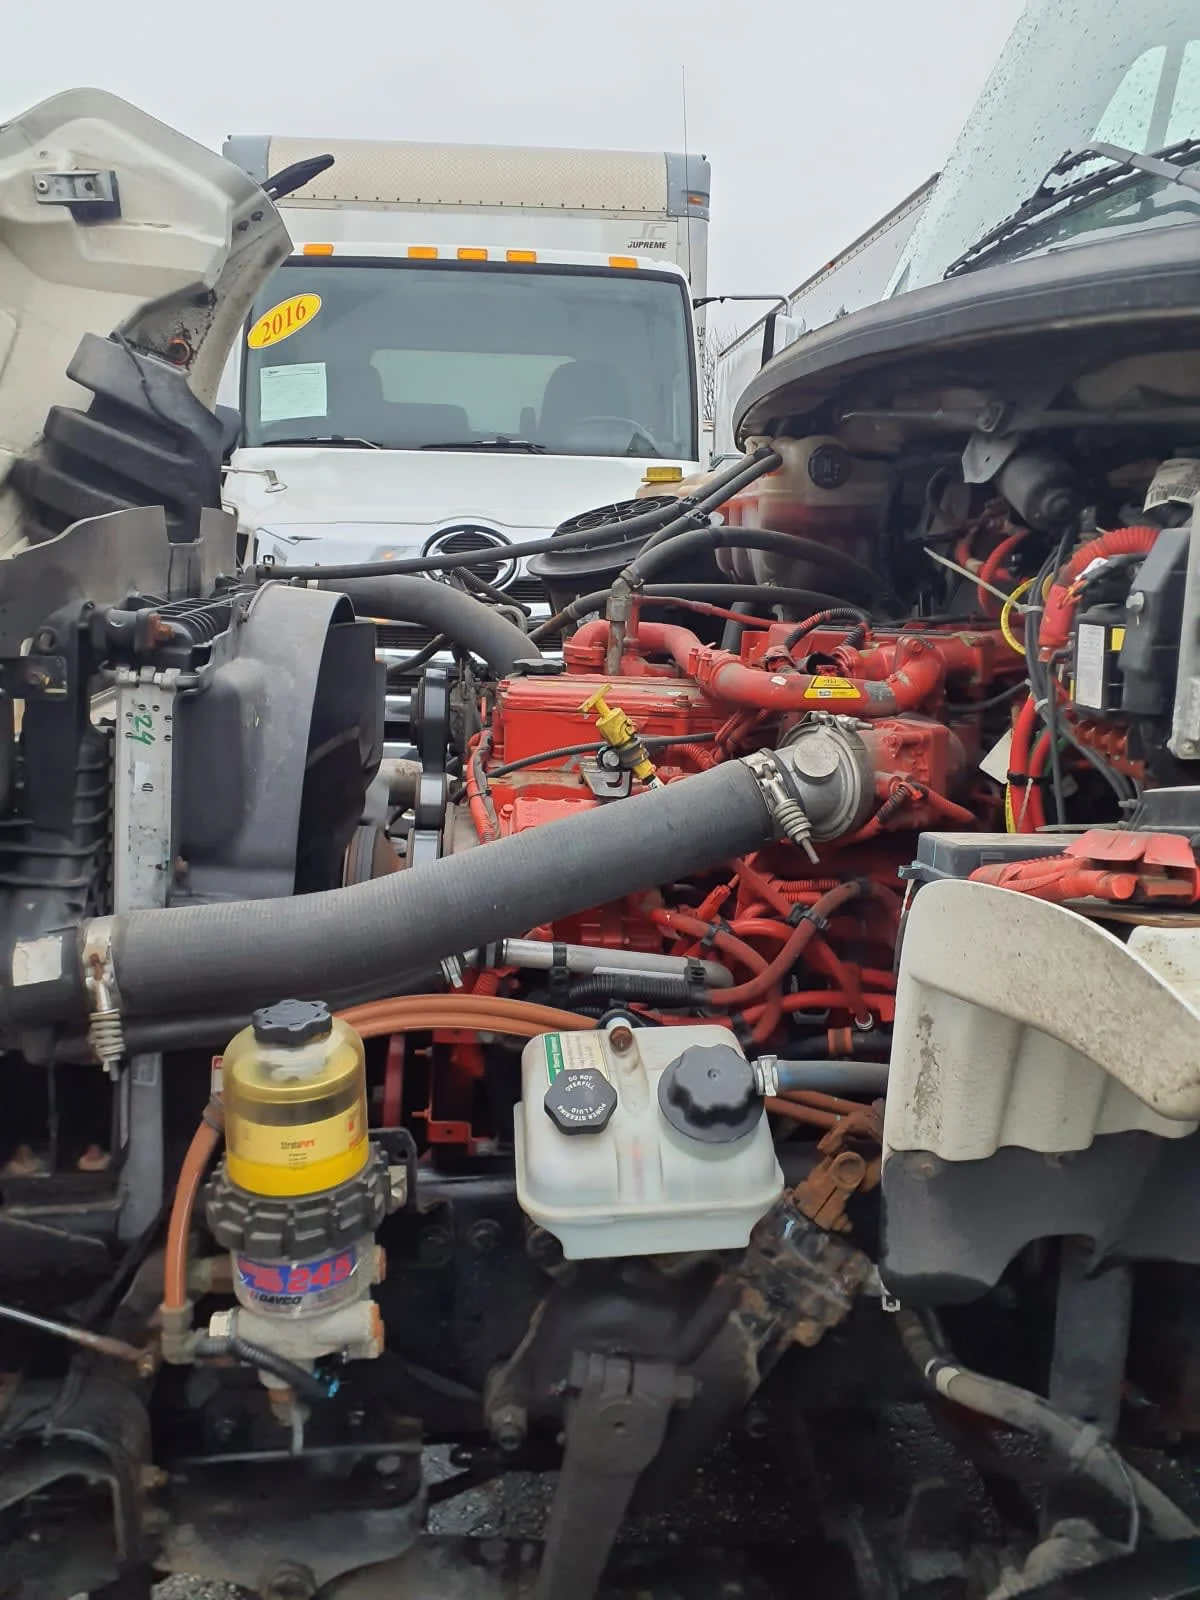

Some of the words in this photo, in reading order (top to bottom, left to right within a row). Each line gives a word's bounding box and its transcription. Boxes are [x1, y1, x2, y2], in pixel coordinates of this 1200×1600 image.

[627, 240, 669, 249] SUPREME
[262, 299, 306, 344] 2016
[132, 714, 156, 746] 24
[571, 1106, 593, 1115] FLUID
[287, 1252, 352, 1293] 245
